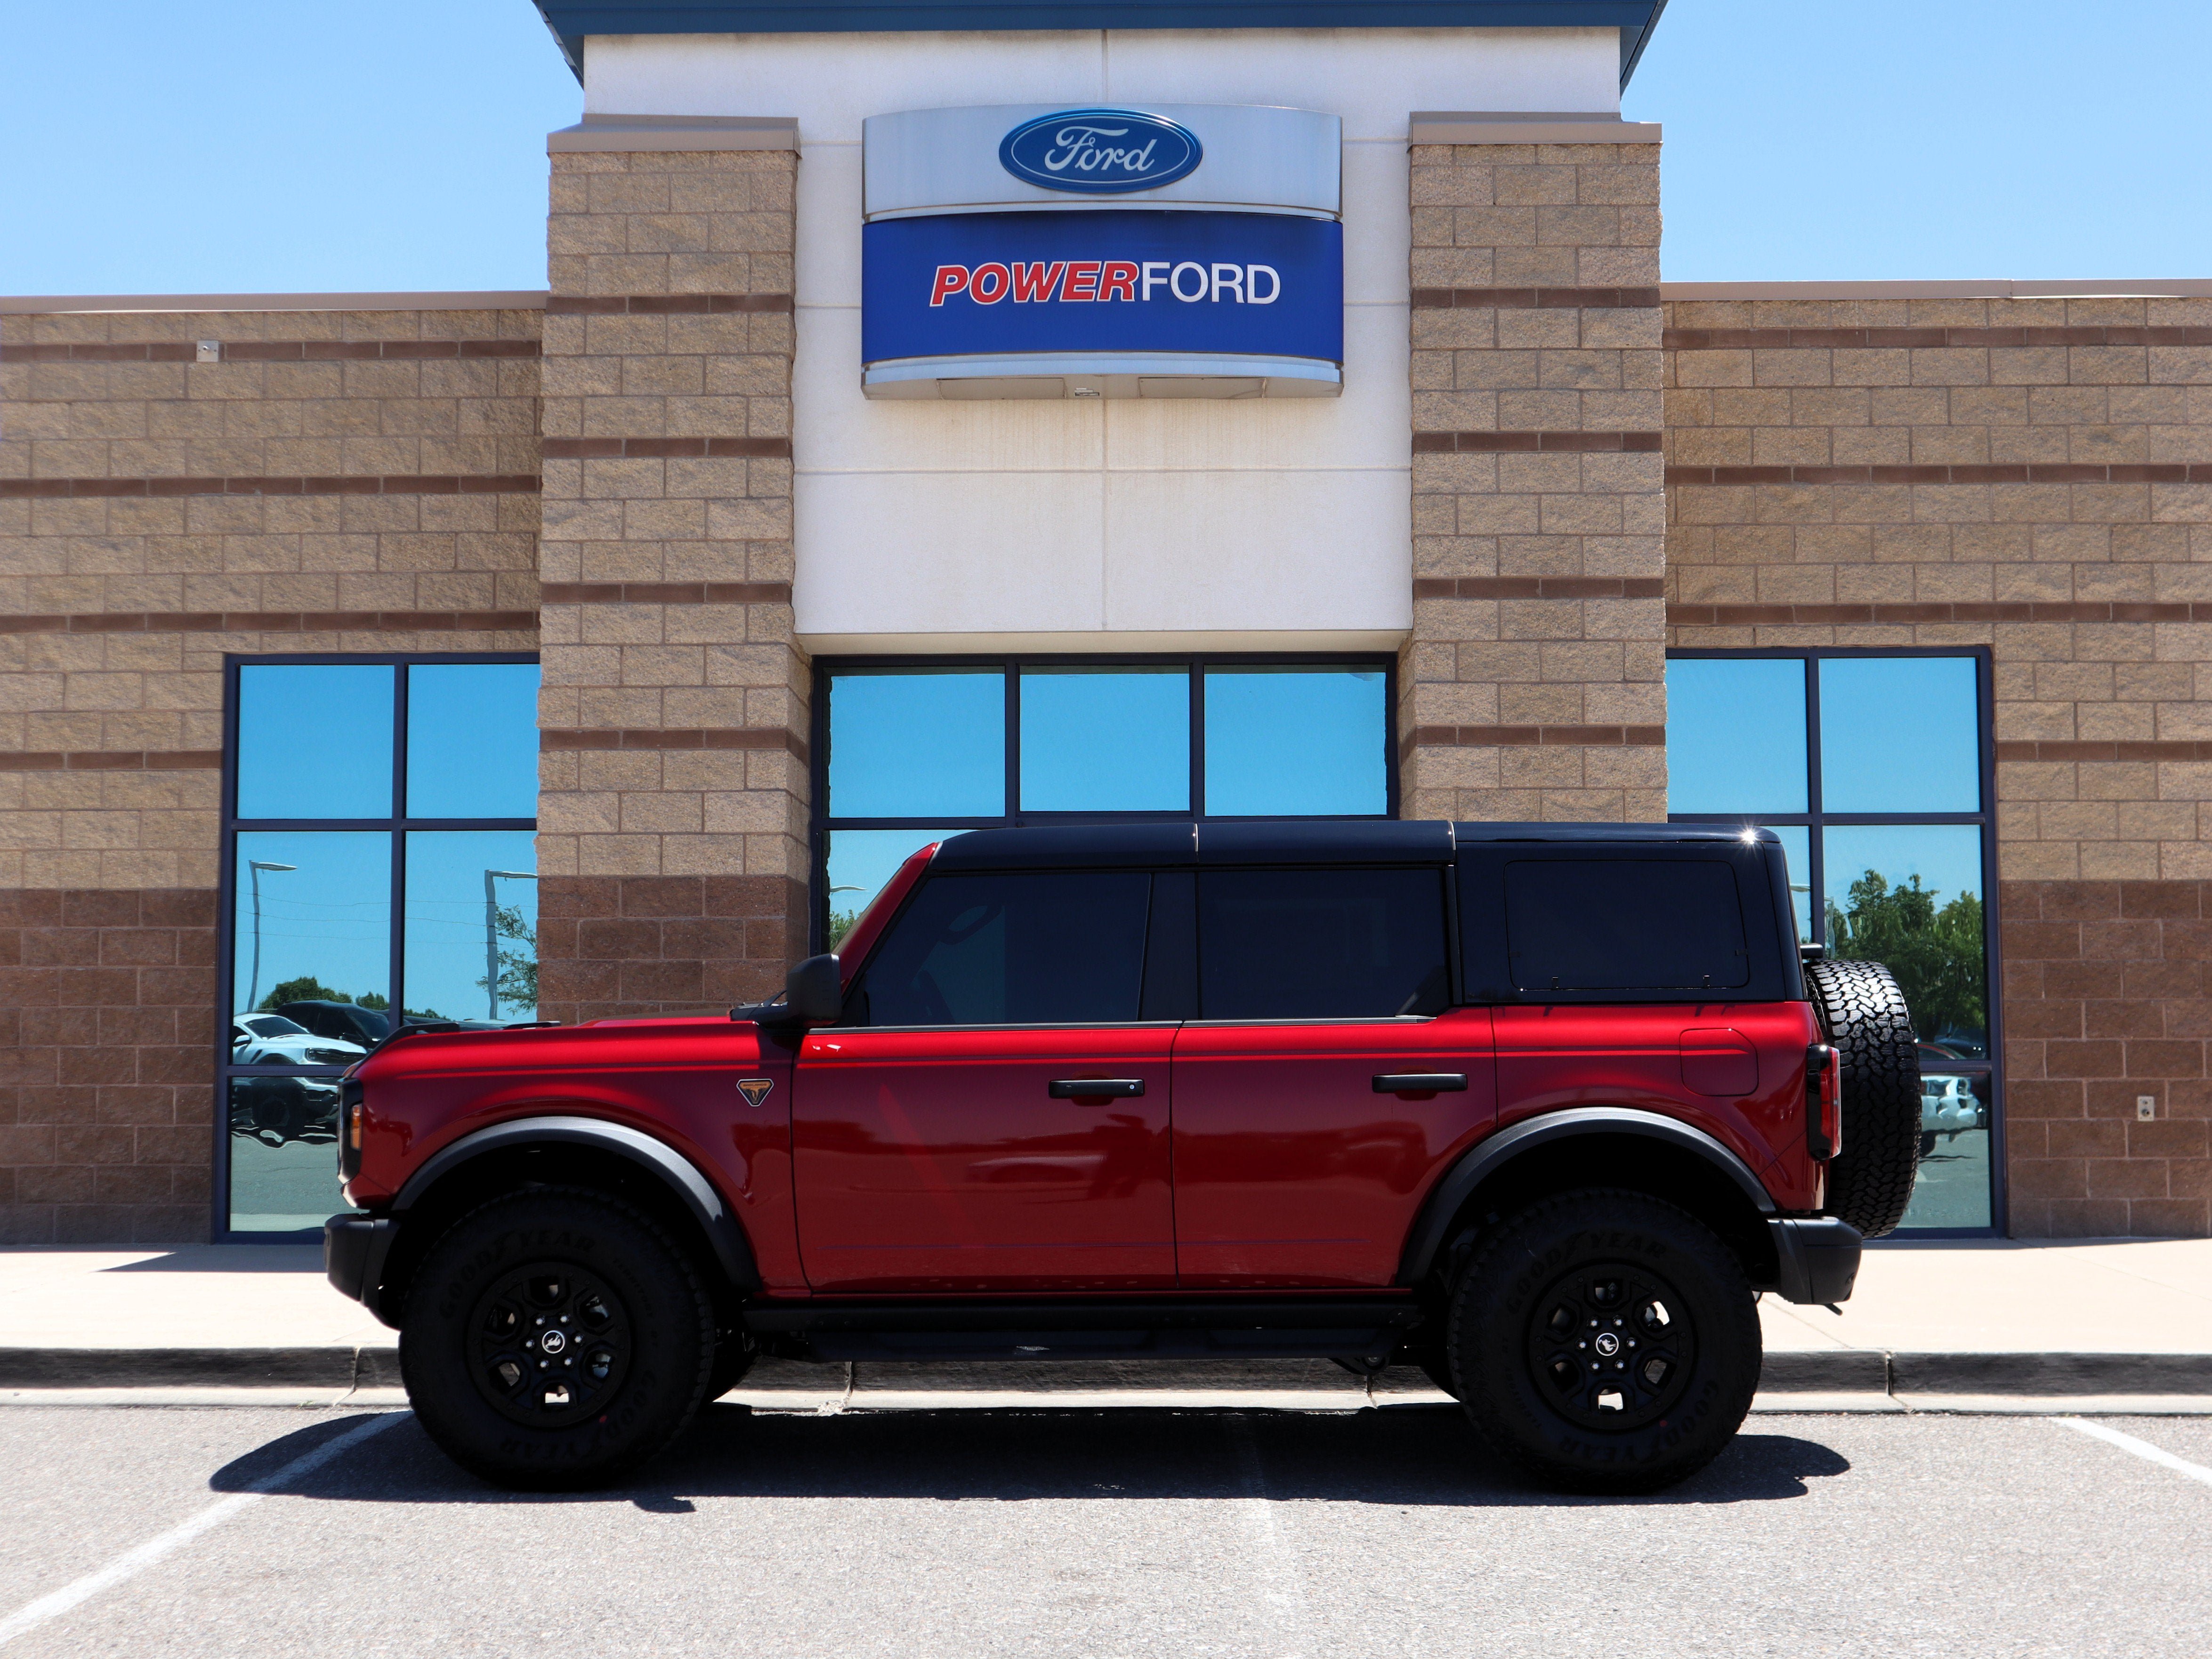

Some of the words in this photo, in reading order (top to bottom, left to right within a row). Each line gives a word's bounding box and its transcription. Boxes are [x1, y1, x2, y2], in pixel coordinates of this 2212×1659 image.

[1044, 125, 1158, 171] Ford
[439, 1229, 596, 1319] GOODYEAR
[1506, 1231, 1667, 1313] GOODYEAR
